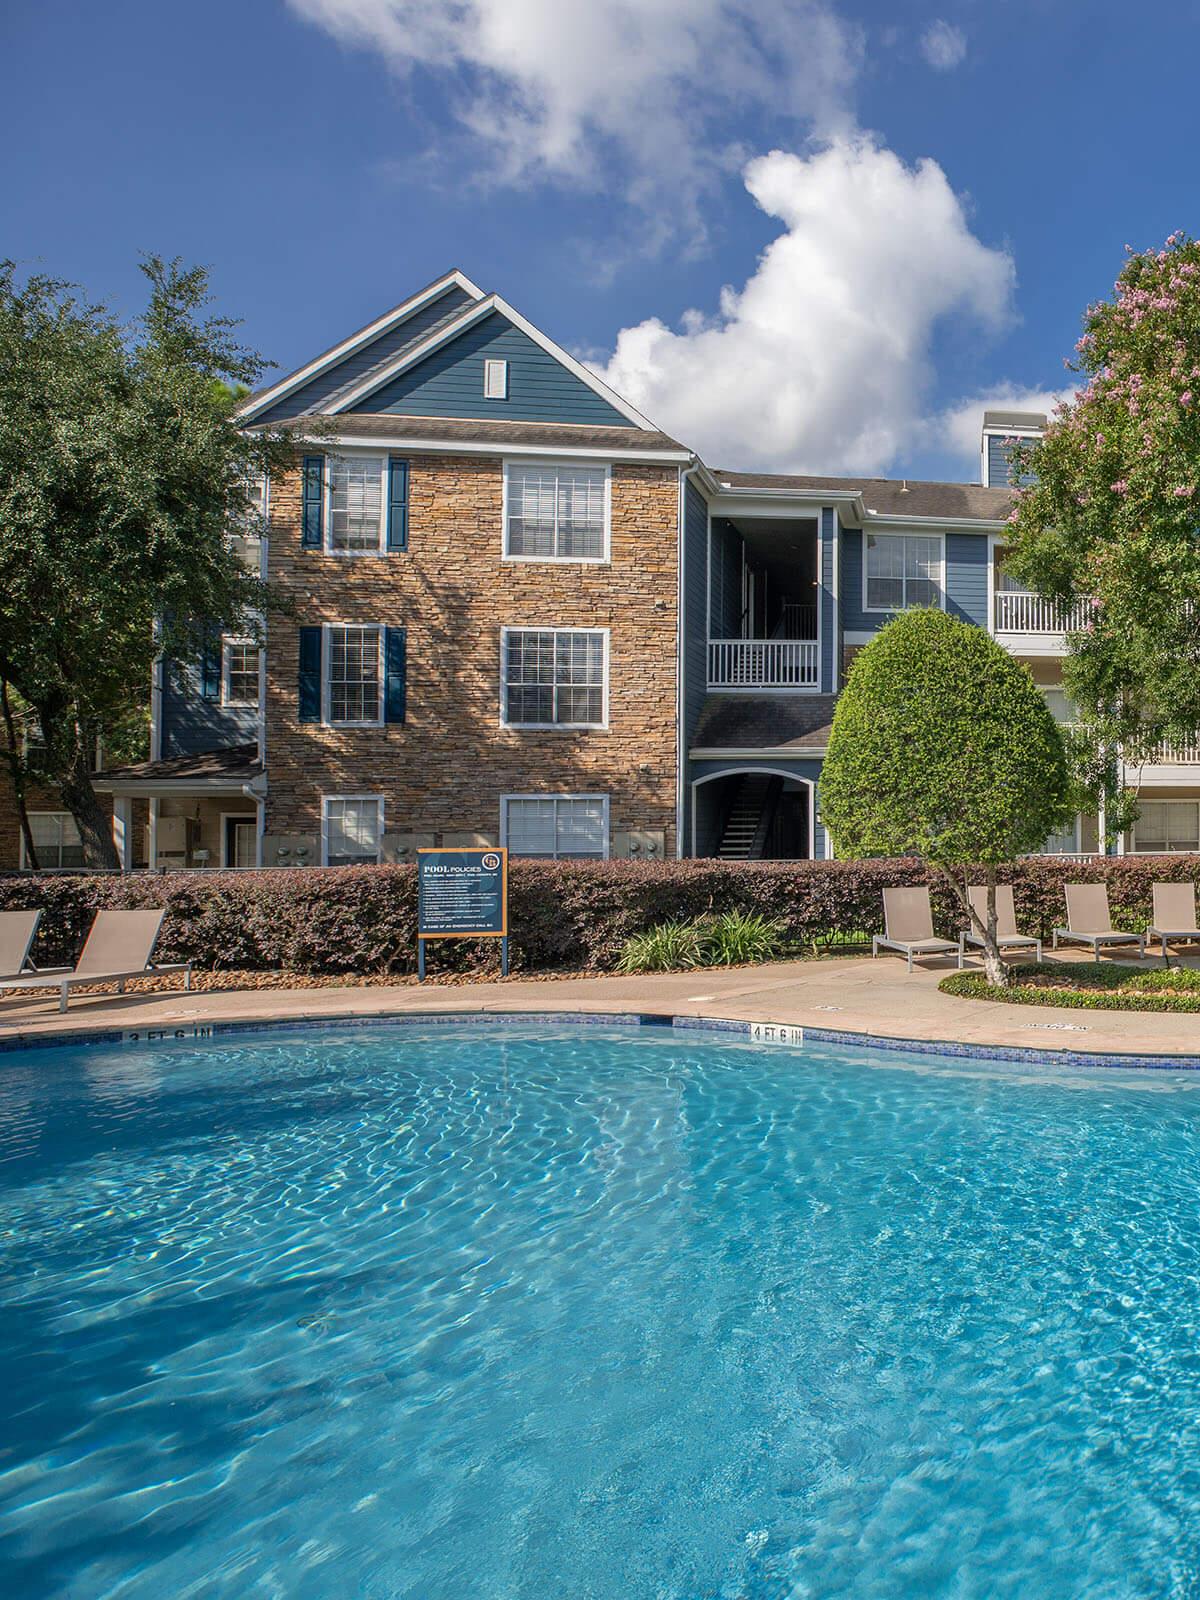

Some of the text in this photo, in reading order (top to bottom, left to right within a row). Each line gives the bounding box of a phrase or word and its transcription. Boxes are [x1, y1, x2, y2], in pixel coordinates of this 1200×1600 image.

[424, 865, 450, 873] POOL
[148, 1030, 167, 1040] FT
[194, 1028, 210, 1040] IN
[754, 1026, 801, 1039] 4 FT 6 IN
